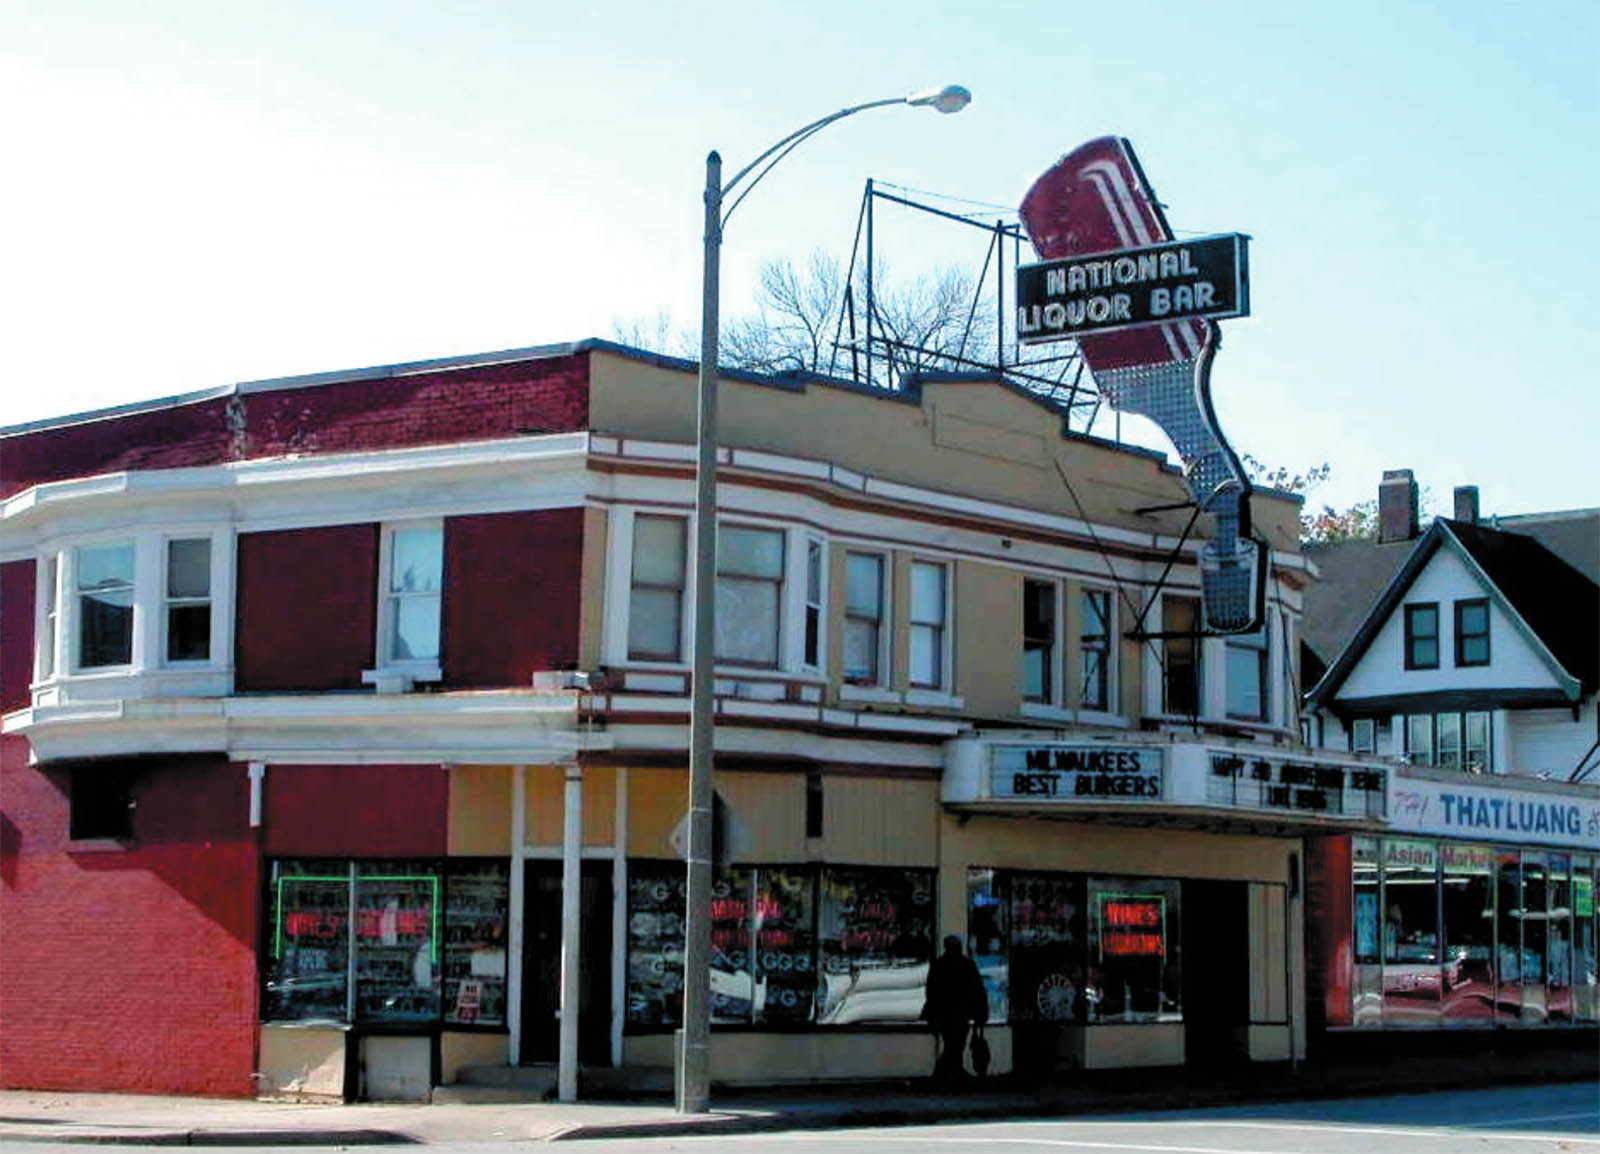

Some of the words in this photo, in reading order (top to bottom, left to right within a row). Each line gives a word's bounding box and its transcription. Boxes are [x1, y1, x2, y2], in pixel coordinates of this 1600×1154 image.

[1046, 248, 1198, 296] NATIONAL
[1018, 294, 1131, 331] LIQUOR
[1150, 281, 1216, 316] BAR
[1026, 750, 1141, 772] MILWAUKEES
[1013, 773, 1061, 795] BEST
[1075, 775, 1159, 797] BURGERS
[1440, 794, 1580, 836] THATLUANG
